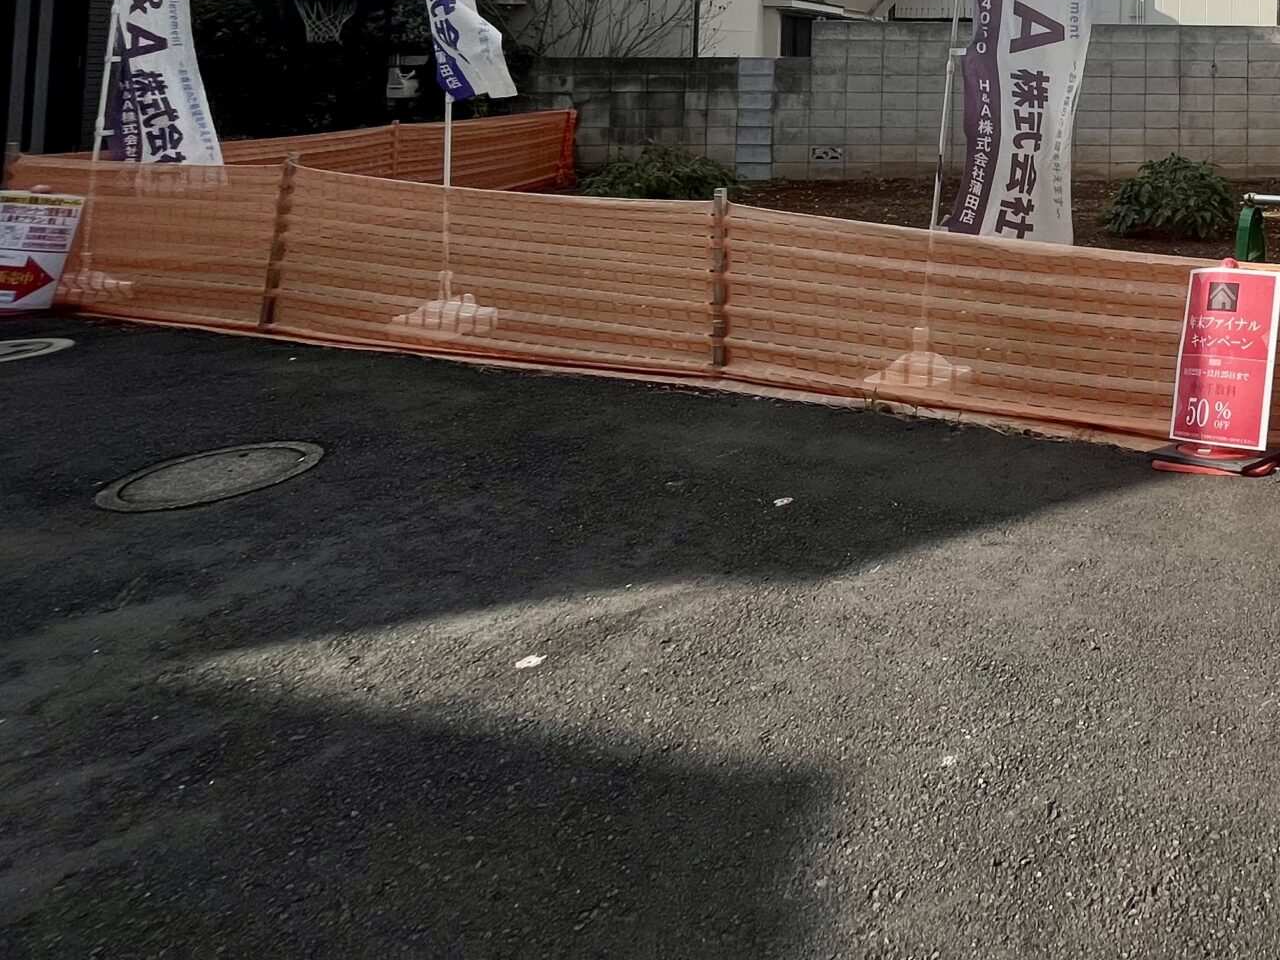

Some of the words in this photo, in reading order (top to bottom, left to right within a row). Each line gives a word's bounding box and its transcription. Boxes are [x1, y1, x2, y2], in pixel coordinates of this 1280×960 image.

[1191, 334, 1254, 350] キャンペーン
[1213, 420, 1231, 430] OFF
